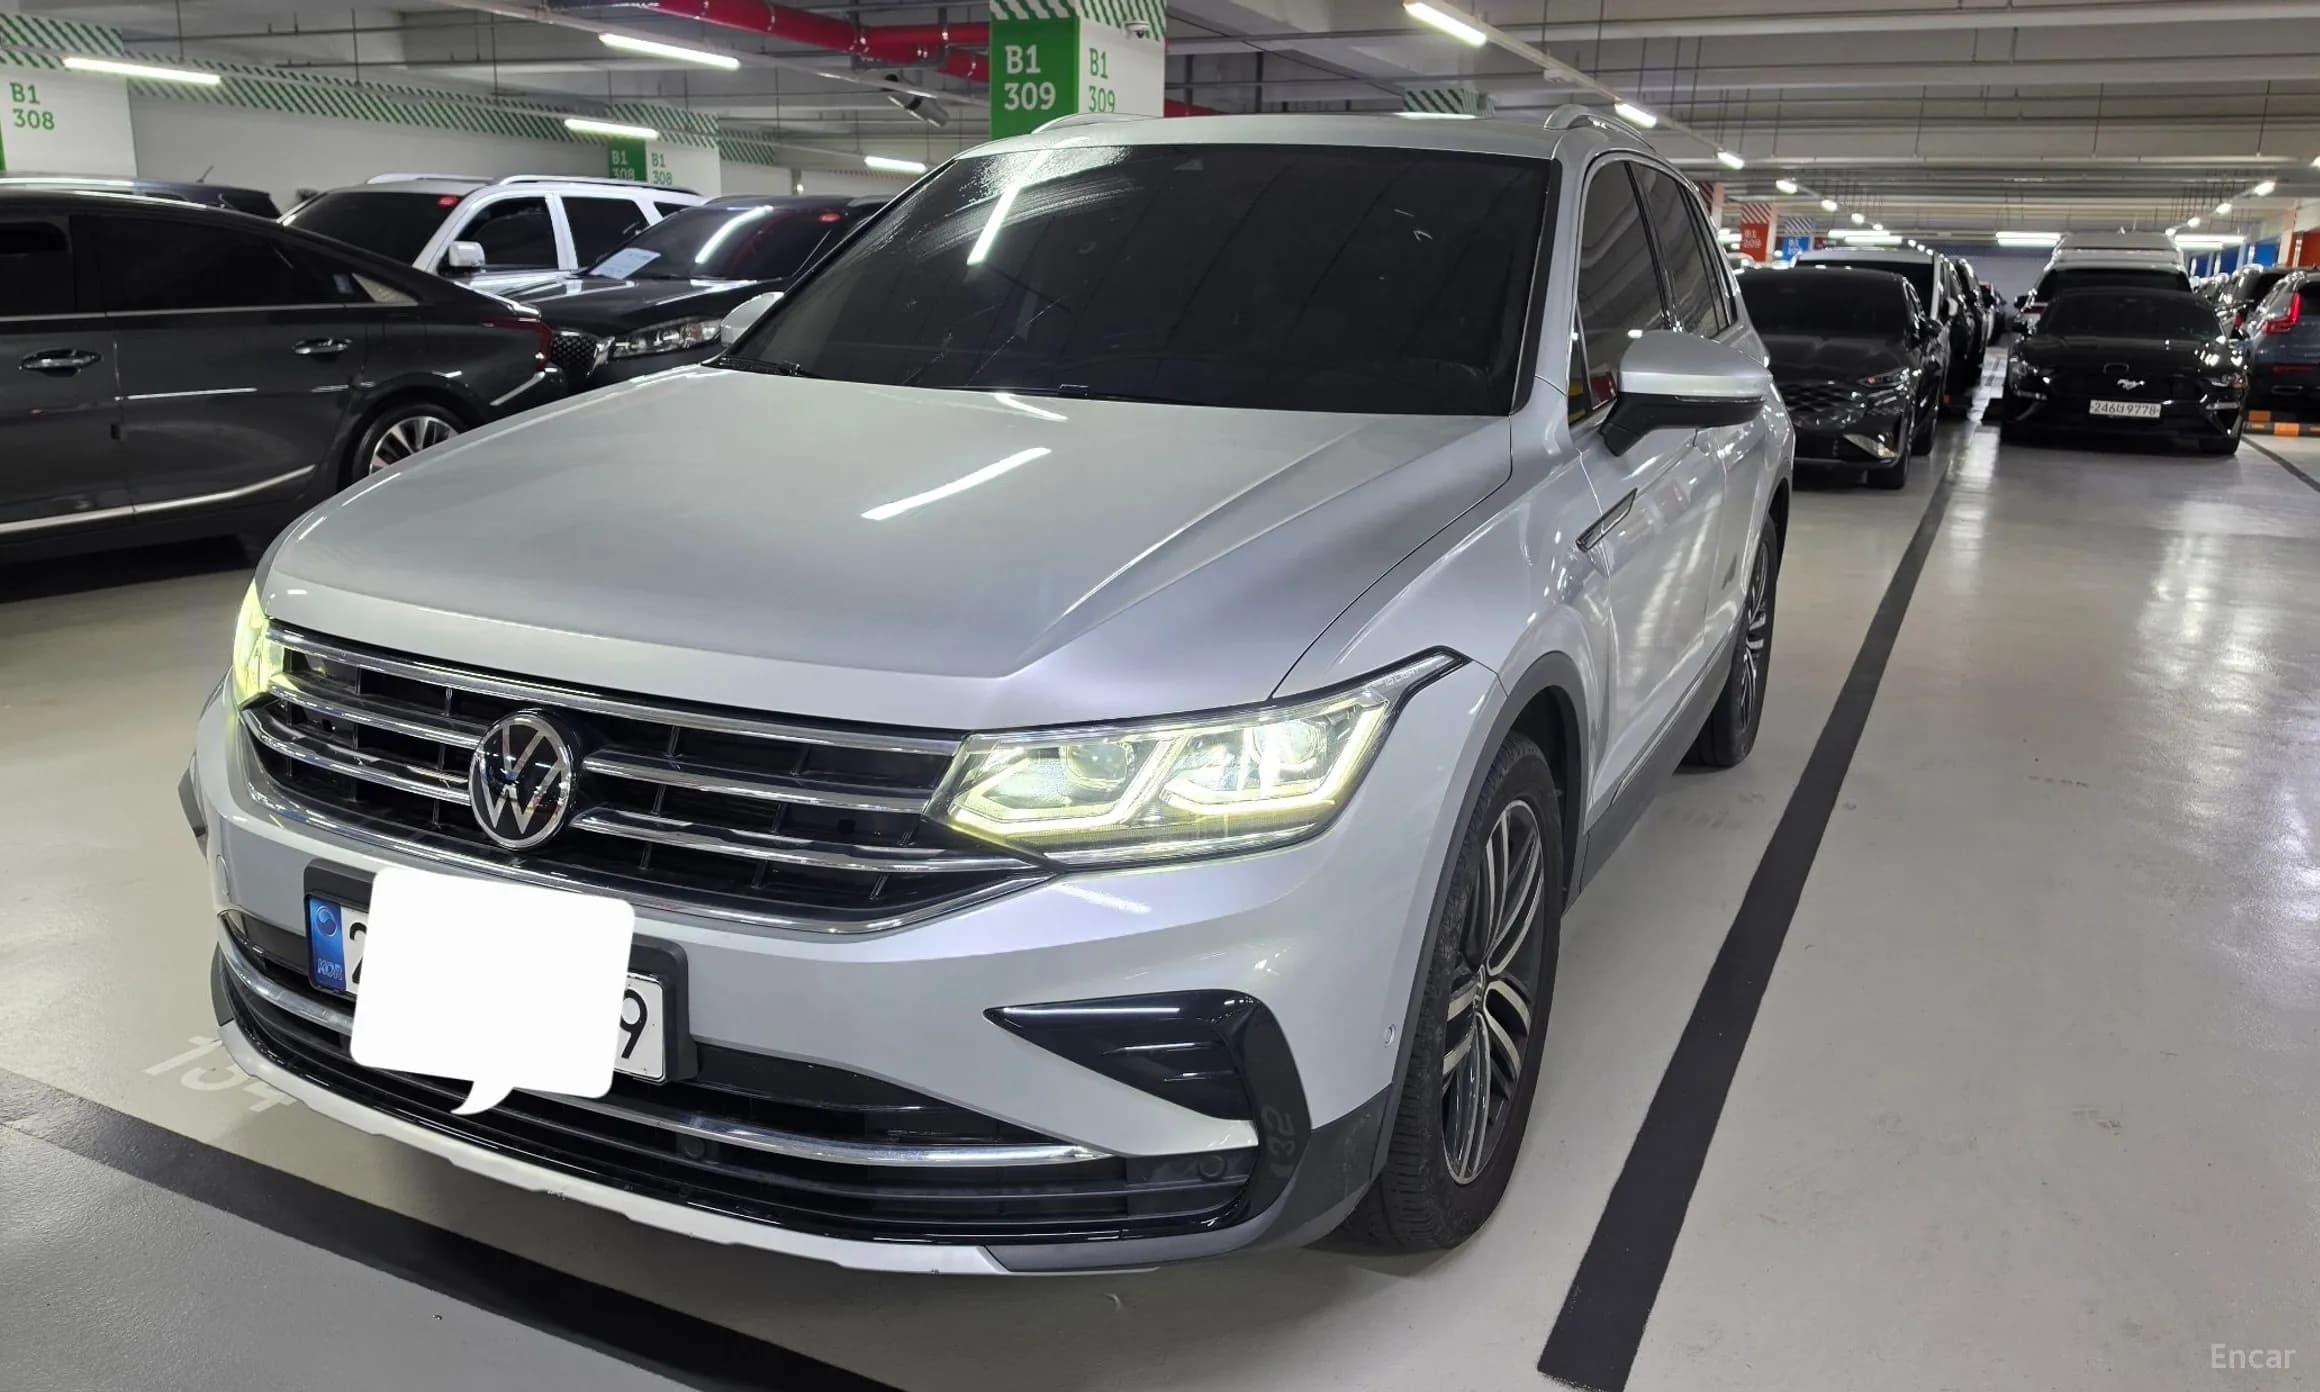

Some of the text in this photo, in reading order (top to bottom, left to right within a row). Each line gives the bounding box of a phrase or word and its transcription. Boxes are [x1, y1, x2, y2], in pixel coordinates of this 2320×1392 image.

[1004, 45, 1041, 74] B1
[1088, 47, 1109, 79] B1
[9, 81, 41, 105] B1
[1003, 82, 1057, 111] 309
[1088, 85, 1116, 113] 309
[12, 107, 56, 130] 308
[611, 149, 629, 165] B1
[651, 152, 666, 168] B1
